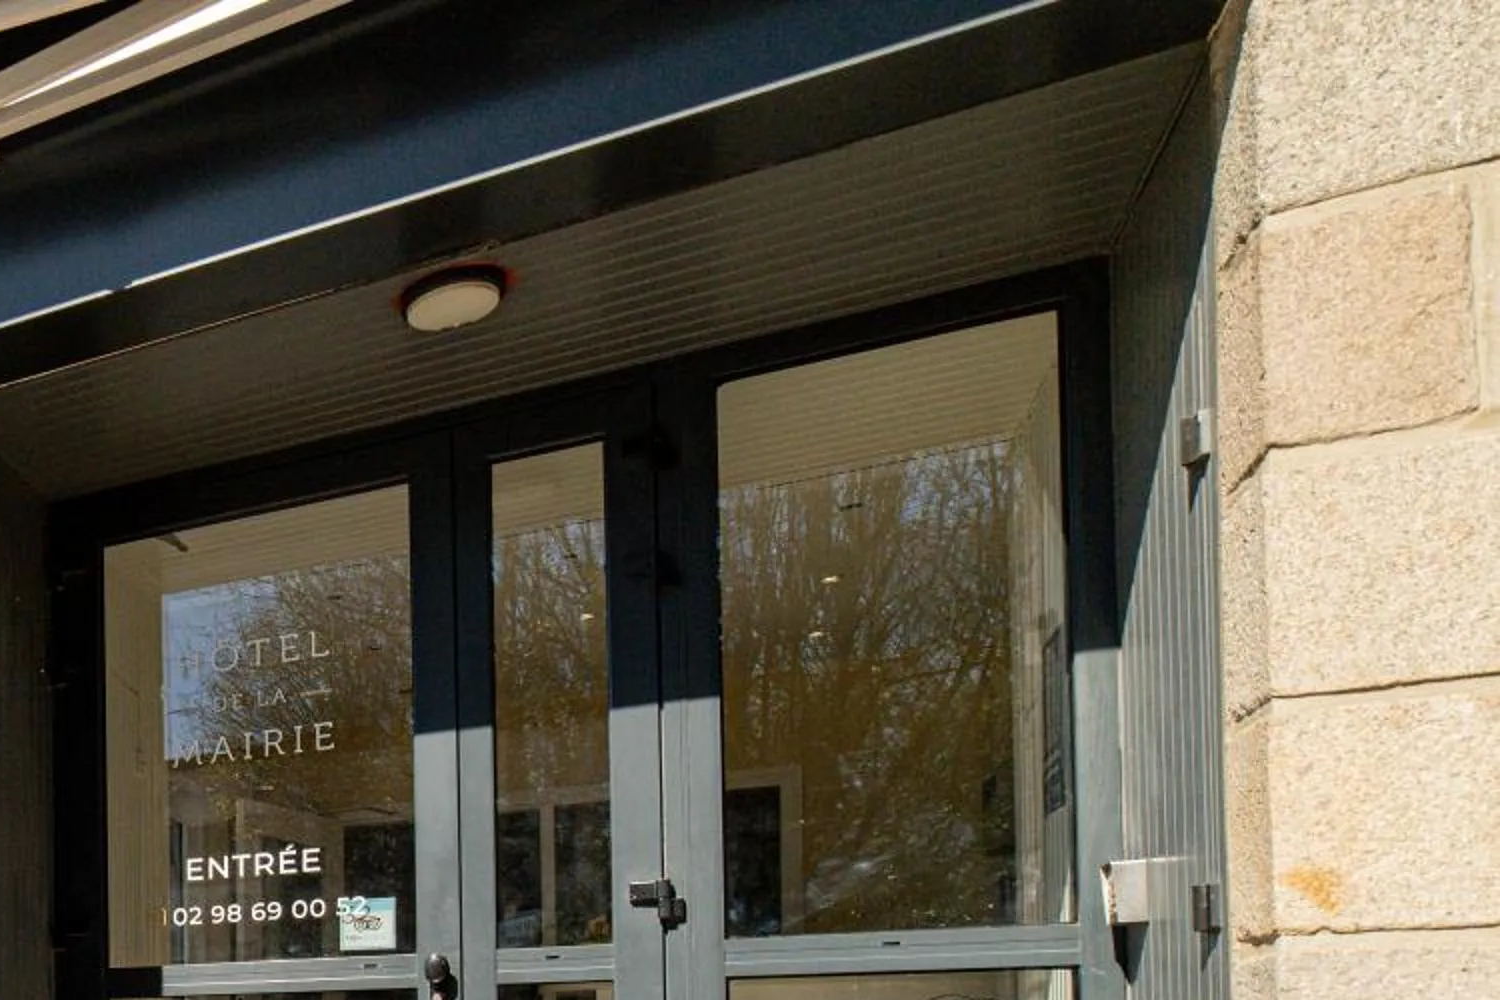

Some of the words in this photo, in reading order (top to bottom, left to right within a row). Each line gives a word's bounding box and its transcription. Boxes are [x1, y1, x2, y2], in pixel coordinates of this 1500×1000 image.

[257, 687, 287, 708] LA
[172, 721, 336, 769] MAIRIE
[186, 843, 321, 882] ENTRÉE
[173, 906, 204, 927] 02
[211, 903, 243, 925] 98
[251, 900, 283, 922] 69
[291, 898, 326, 919] 00
[336, 895, 367, 916] 52
